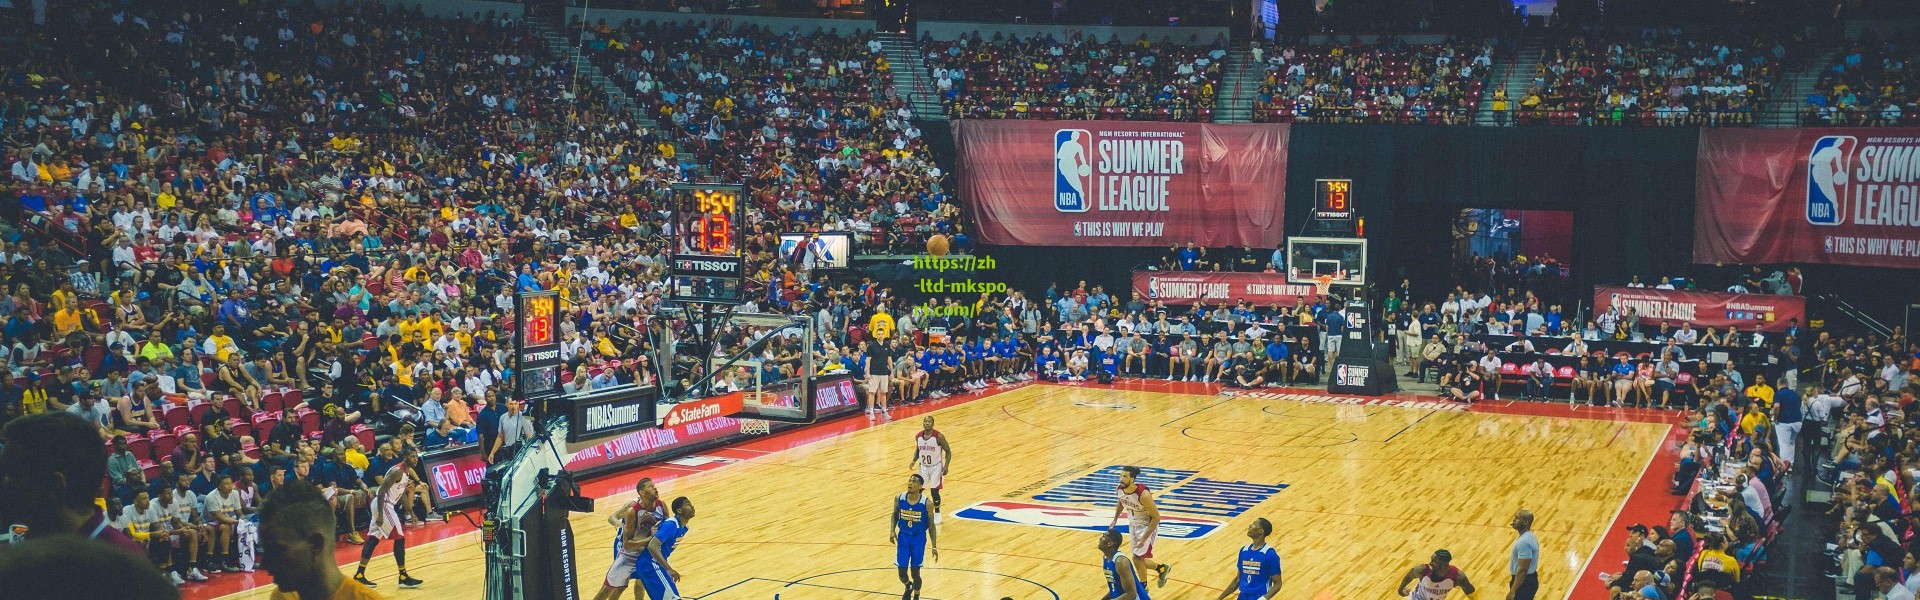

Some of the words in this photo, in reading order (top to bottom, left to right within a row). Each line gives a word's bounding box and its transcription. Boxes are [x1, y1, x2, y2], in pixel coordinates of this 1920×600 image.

[1113, 130, 1139, 138] RESORTS
[1098, 139, 1184, 175] SUMMER
[1098, 175, 1170, 212] LEAGUE
[1327, 181, 1348, 192] 7:54
[695, 191, 735, 215] 7:54
[1059, 192, 1077, 206] NBA
[1329, 193, 1345, 209] 13
[1811, 202, 1830, 218] NBA
[699, 216, 728, 253] 13
[1082, 221, 1101, 237] THIS
[1102, 221, 1111, 237] IS
[1112, 222, 1131, 237] WHY
[1131, 222, 1144, 237] WE
[1144, 222, 1165, 237] PLAY
[1834, 236, 1855, 254] THIS
[1856, 237, 1866, 254] IS
[1867, 238, 1889, 255] WHY
[1890, 239, 1904, 256] WE
[692, 261, 737, 272] TISSOT
[1159, 282, 1197, 299] SUMMER
[1252, 283, 1266, 295] THIS
[1266, 283, 1273, 295] IS
[1273, 284, 1287, 296] WHY
[1287, 284, 1296, 296] WE
[1296, 285, 1311, 296] PLAY
[1662, 302, 1697, 321] LEAGUE
[1726, 302, 1775, 312] #NBASummer
[534, 319, 548, 341] 13
[534, 350, 559, 361] TISSOT
[1348, 367, 1369, 378] SUMMER
[1365, 397, 1470, 412] LEAGUE
[586, 403, 640, 431] #NBASummer
[685, 422, 705, 436] MGM
[705, 417, 738, 433] RESORTS
[612, 429, 651, 457] SUMMER
[921, 455, 932, 464] 20
[443, 469, 458, 490] TV
[907, 520, 913, 528] 6
[562, 548, 571, 583] RESORTS
